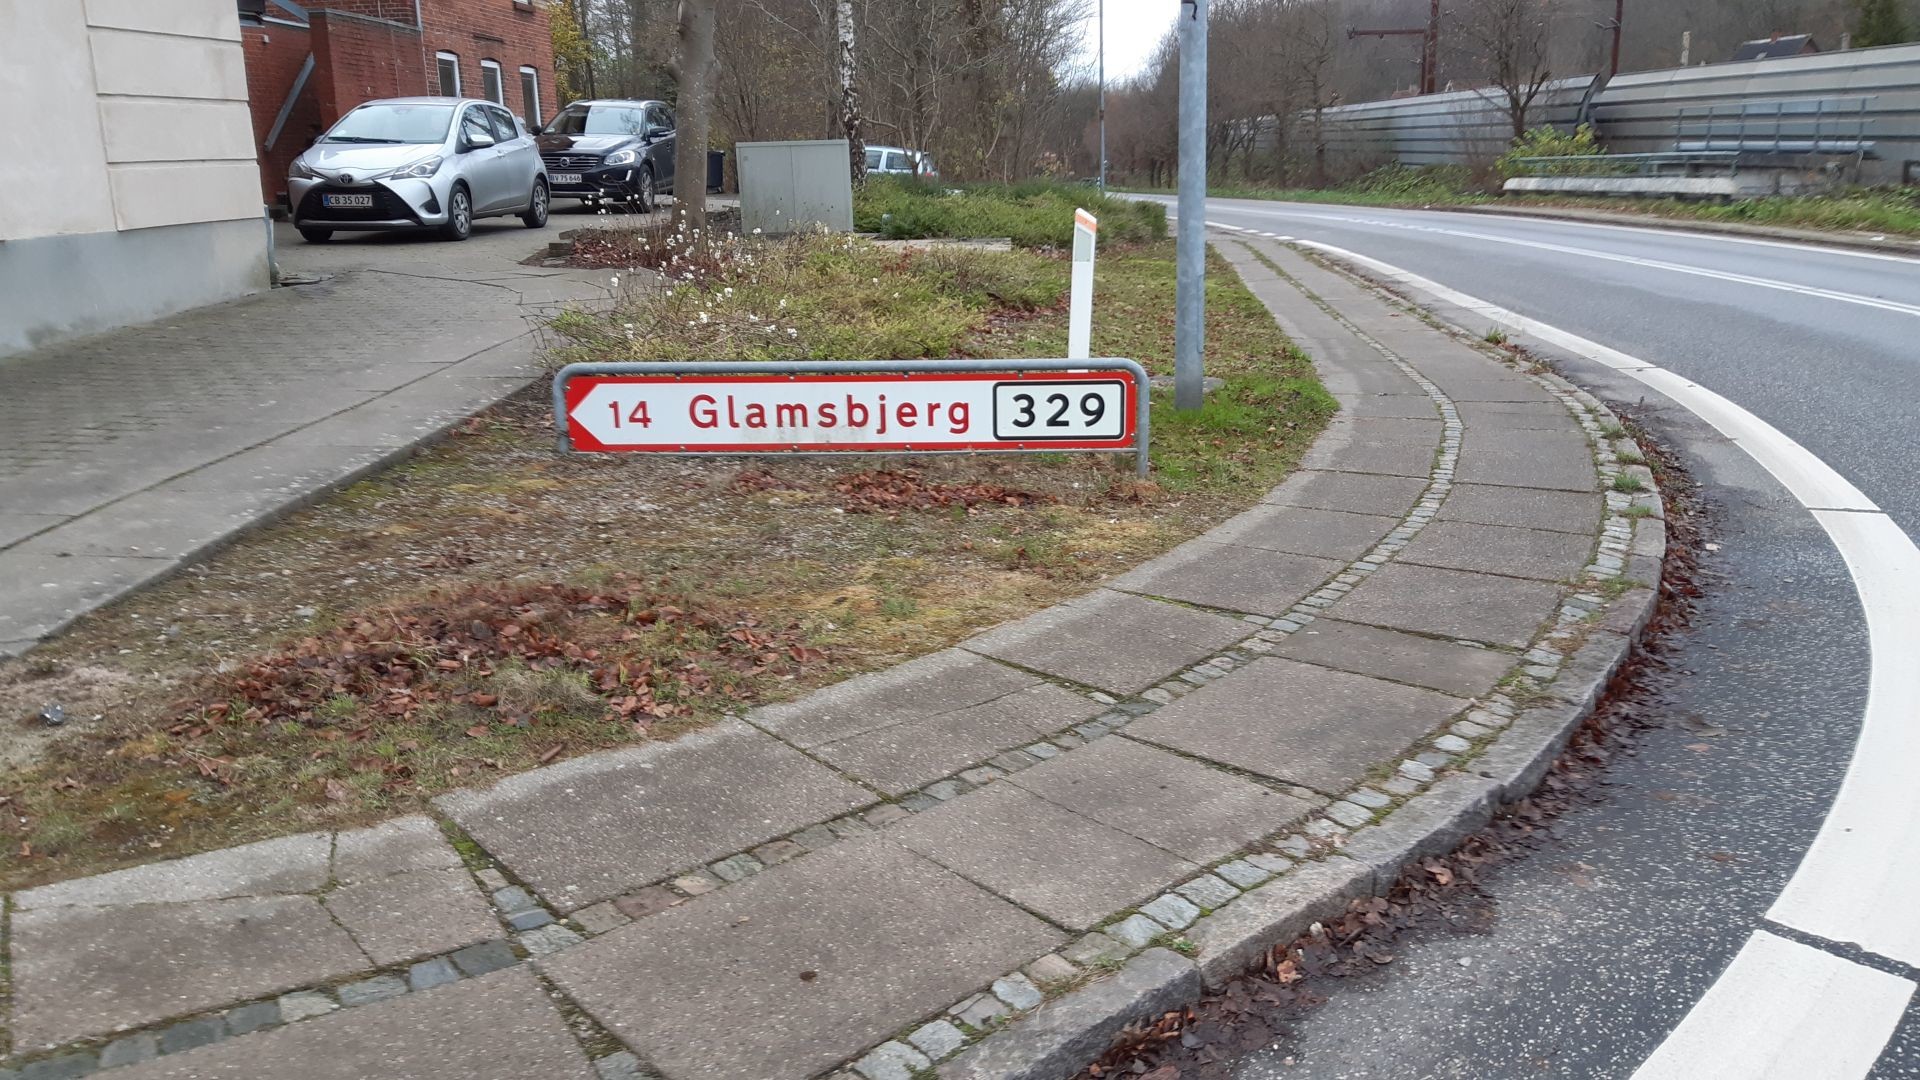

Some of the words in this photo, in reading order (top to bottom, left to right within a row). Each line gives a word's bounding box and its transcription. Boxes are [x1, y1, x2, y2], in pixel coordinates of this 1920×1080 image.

[560, 174, 568, 182] 75
[329, 196, 341, 205] CB
[341, 196, 353, 205] 35
[354, 196, 370, 205] 027
[608, 400, 652, 429] 14
[689, 393, 970, 434] Glamsbjerg
[1011, 392, 1106, 428] 329
